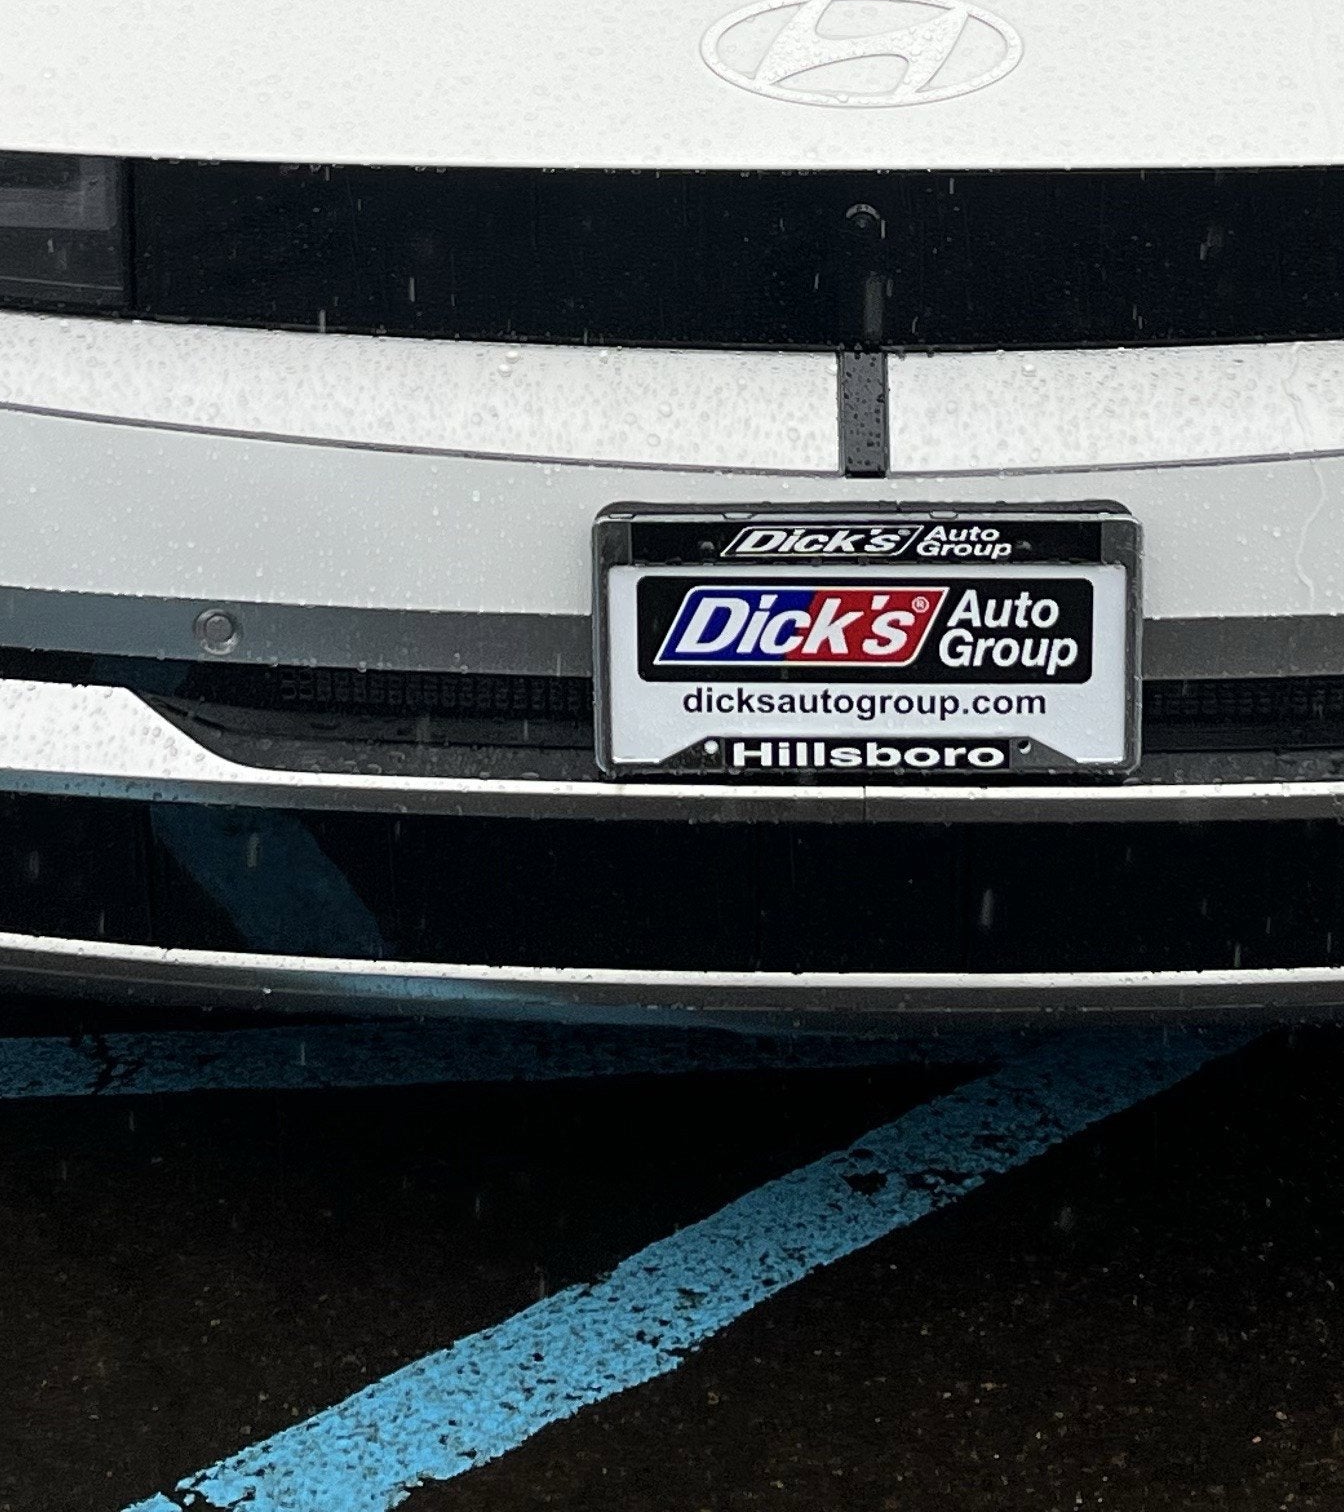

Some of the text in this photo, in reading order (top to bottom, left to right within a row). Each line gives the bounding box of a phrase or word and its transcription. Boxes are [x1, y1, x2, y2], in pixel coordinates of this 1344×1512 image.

[735, 528, 901, 553] Dick's
[924, 525, 1000, 541] Auto
[916, 539, 1012, 559] Group
[947, 589, 1059, 628] Auto
[675, 593, 917, 656] Dick's
[938, 628, 1078, 675] Group
[682, 687, 1047, 720] dicksautogroup.com
[732, 740, 1006, 768] Hillsboro
